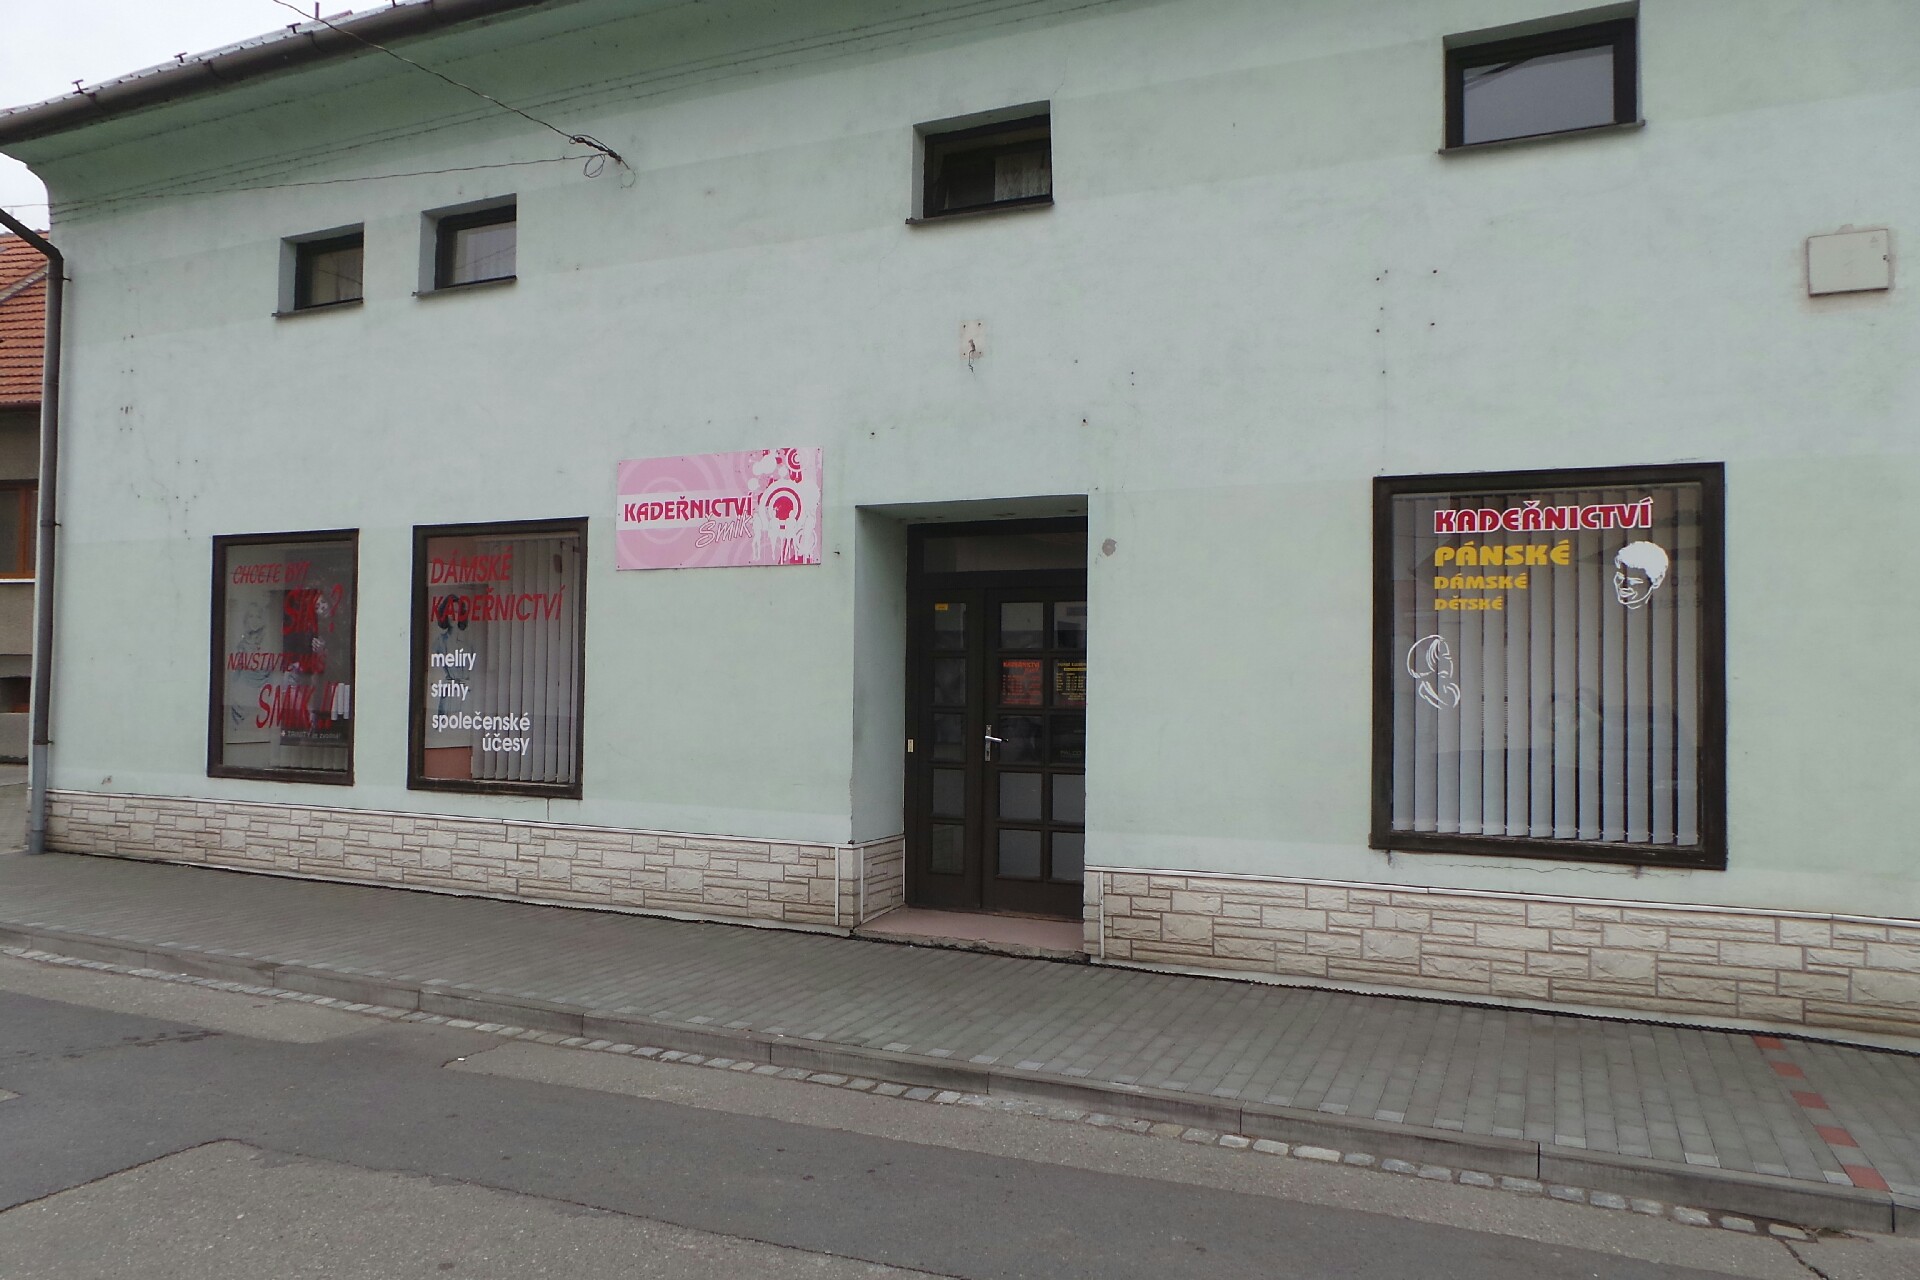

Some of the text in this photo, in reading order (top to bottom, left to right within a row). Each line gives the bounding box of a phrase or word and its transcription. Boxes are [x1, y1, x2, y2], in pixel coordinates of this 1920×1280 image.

[624, 492, 753, 523] KADEŘNICTVÍ
[1433, 497, 1655, 534] KADEŘNICTVÍ
[430, 545, 513, 584] DÁMSKÉ
[1433, 539, 1571, 567] PÁNSKÉ
[231, 562, 282, 585] CHCETE
[1433, 572, 1529, 591] DÁMSKÉ
[430, 584, 566, 623] KADEŘNICTVÍ
[1433, 594, 1504, 611] DĚTSKÉ
[431, 648, 477, 671] melíry
[431, 711, 531, 733] společenské
[482, 733, 531, 755] účesy
